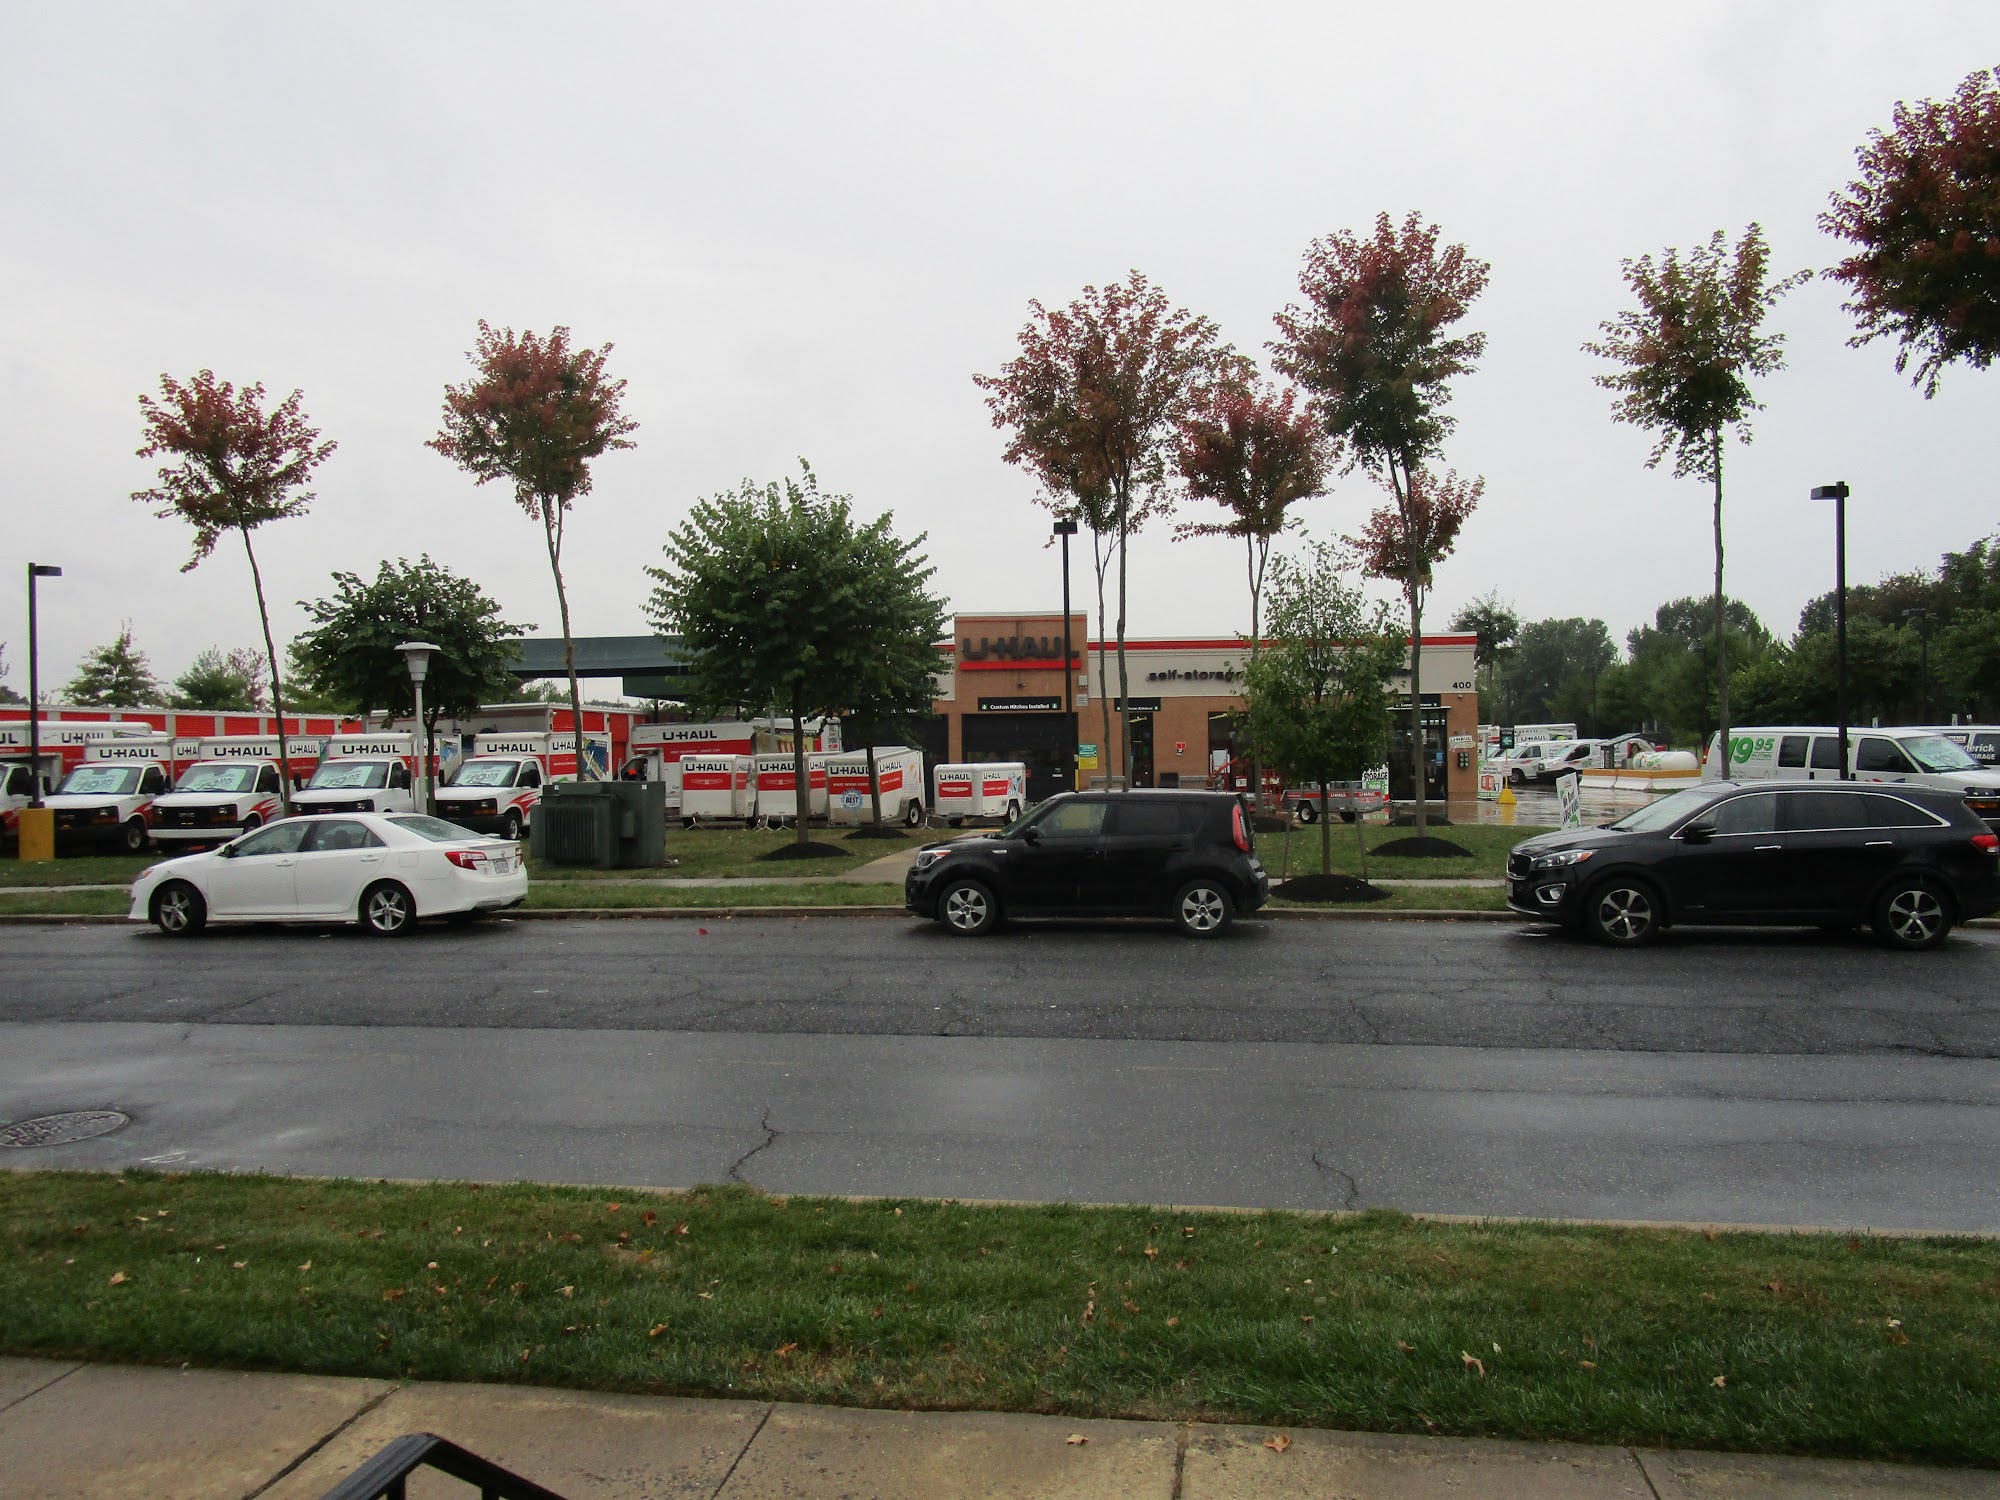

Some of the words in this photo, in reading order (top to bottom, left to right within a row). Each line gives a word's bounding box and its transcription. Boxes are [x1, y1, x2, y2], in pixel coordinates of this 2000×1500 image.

[1452, 681, 1472, 689] 400
[662, 729, 718, 740] U-HAUL
[289, 744, 318, 754] U-HAUL
[342, 744, 401, 754] U-HAUL
[486, 743, 537, 752] U-HAUL
[552, 741, 577, 750] U-HAU
[99, 748, 159, 758] U-HAUL
[214, 747, 273, 756] U-HAUL
[685, 763, 729, 771] U-HAUL
[759, 763, 796, 771] U-HAU
[879, 761, 902, 772] U-HAUL
